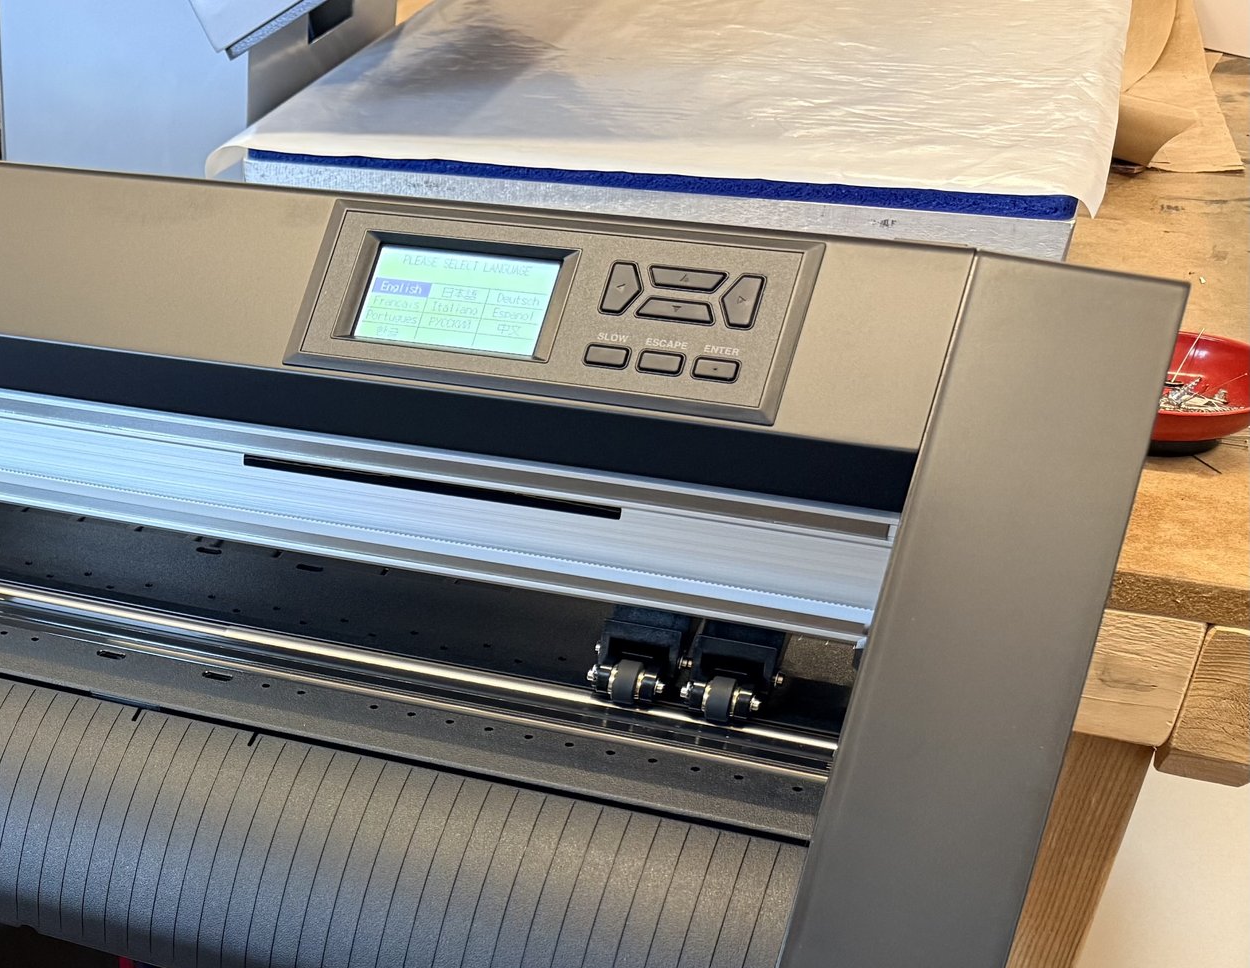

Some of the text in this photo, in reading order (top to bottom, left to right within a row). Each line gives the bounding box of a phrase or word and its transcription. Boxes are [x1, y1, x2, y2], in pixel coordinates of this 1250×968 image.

[403, 254, 533, 277] PLEASE SELECT LANGUAGE
[380, 279, 423, 295] English
[441, 286, 479, 300] 日本語
[496, 292, 541, 307] Deutsch
[431, 300, 479, 316] Italiano
[497, 323, 521, 337] 中文
[597, 332, 629, 343] SLOW
[645, 337, 688, 350] ESCAPE
[703, 344, 740, 356] ENTER
